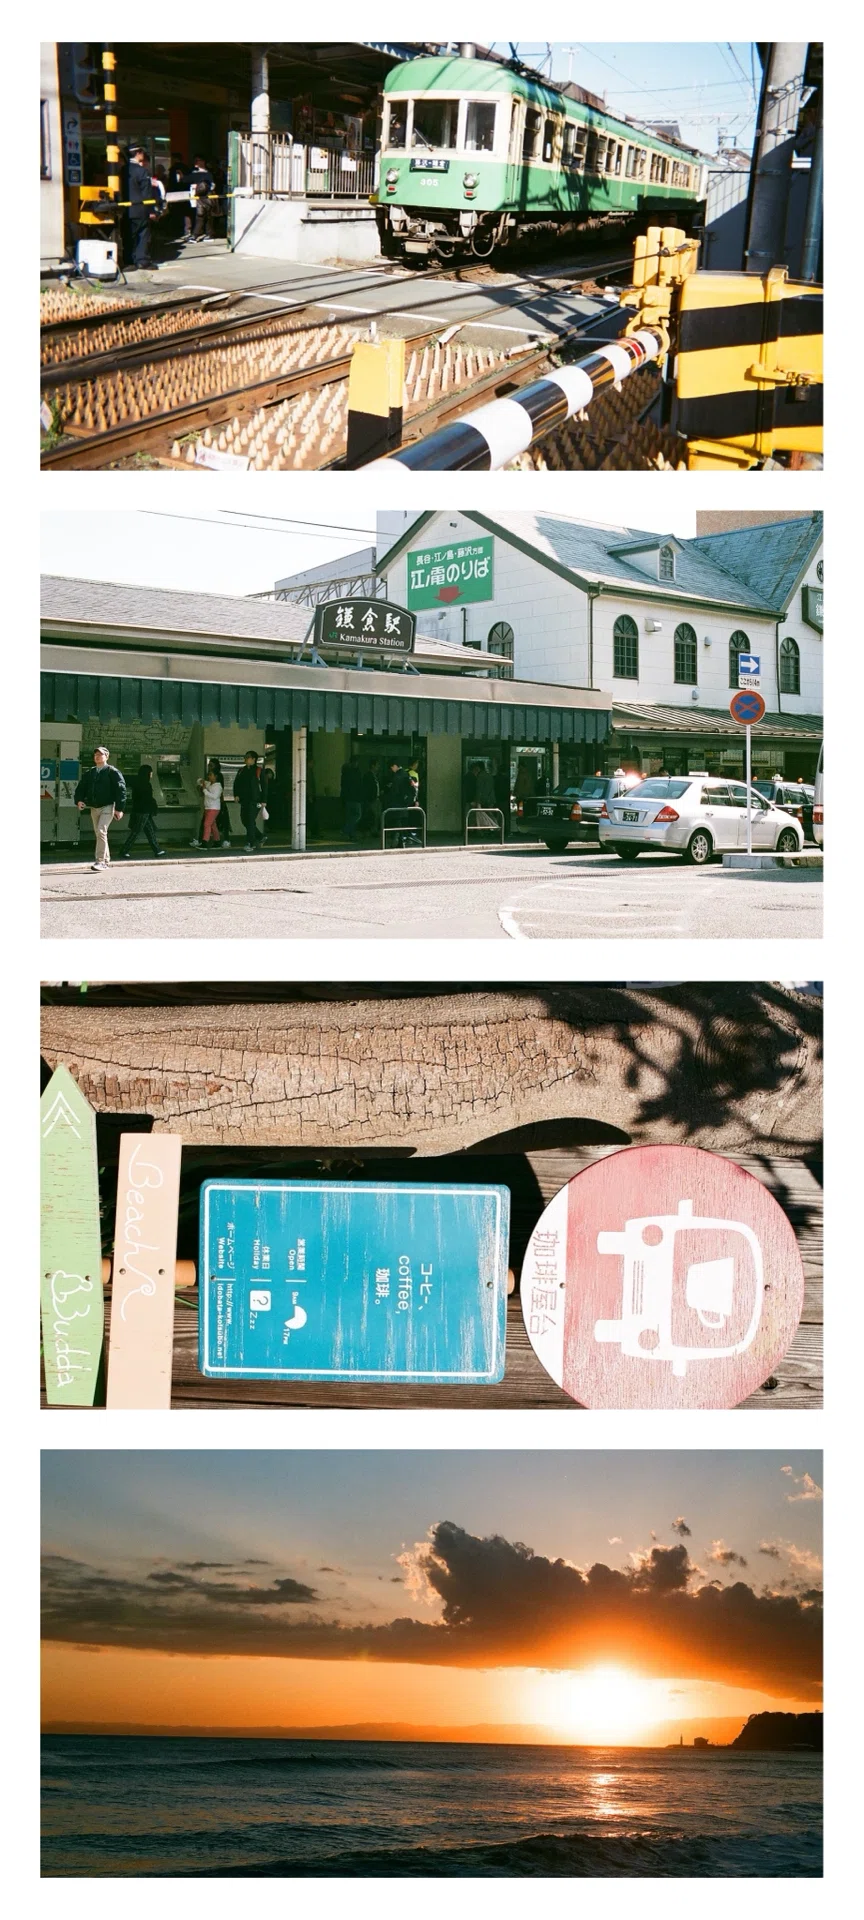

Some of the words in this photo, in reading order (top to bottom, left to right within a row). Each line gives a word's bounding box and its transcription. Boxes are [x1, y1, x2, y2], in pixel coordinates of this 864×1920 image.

[410, 556, 491, 590] 江ノ電のりば
[335, 606, 401, 634] 鎌倉駅
[340, 633, 378, 644] Kamakura
[379, 637, 404, 647] Station
[123, 1144, 163, 1294] Beach
[217, 1237, 225, 1269] Website
[226, 1222, 235, 1269] ホームページ
[252, 1239, 261, 1270] Holiday
[288, 1249, 296, 1271] Open
[395, 1255, 412, 1314] coffee,
[530, 1230, 560, 1336] 珈琲屋台
[50, 1271, 93, 1387] Budda
